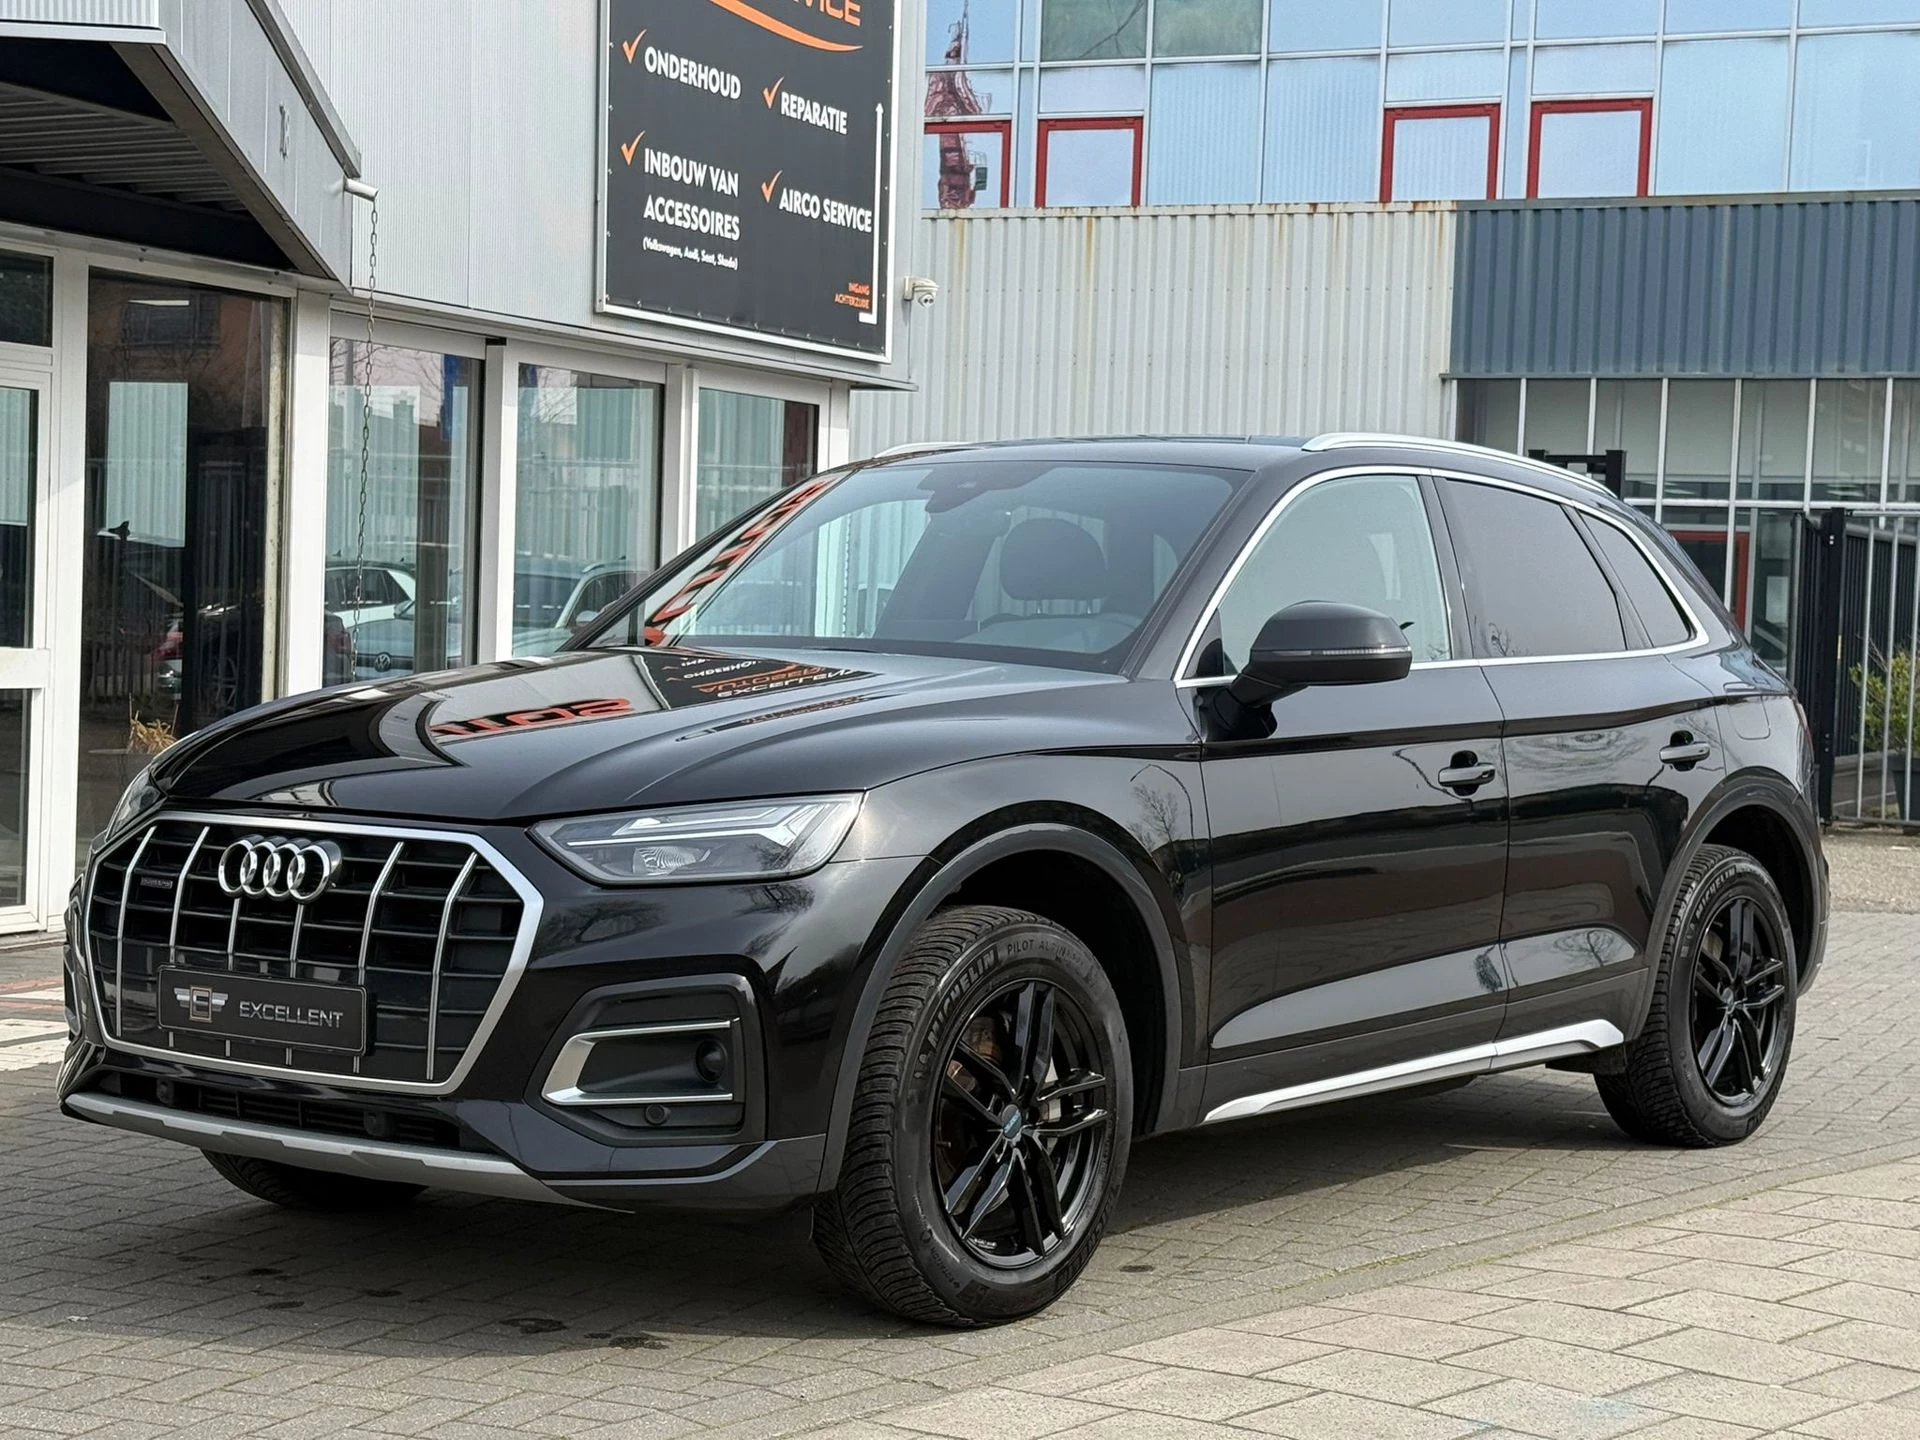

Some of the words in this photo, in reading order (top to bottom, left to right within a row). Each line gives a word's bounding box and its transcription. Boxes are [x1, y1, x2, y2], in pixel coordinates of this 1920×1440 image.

[644, 46, 741, 101] ONDERHOUD
[781, 91, 848, 135] REPARATIE
[644, 148, 707, 188] INBOUW
[709, 166, 739, 198] VAN
[643, 194, 740, 241] ACCESSOIRES
[779, 187, 820, 221] AIRCO
[823, 199, 872, 233] SERVICE
[1695, 864, 1736, 922] MICHELIN
[239, 1001, 343, 1029] EXCELLENT
[927, 948, 996, 1050] MICHELIN
[1007, 939, 1034, 955] PILOT
